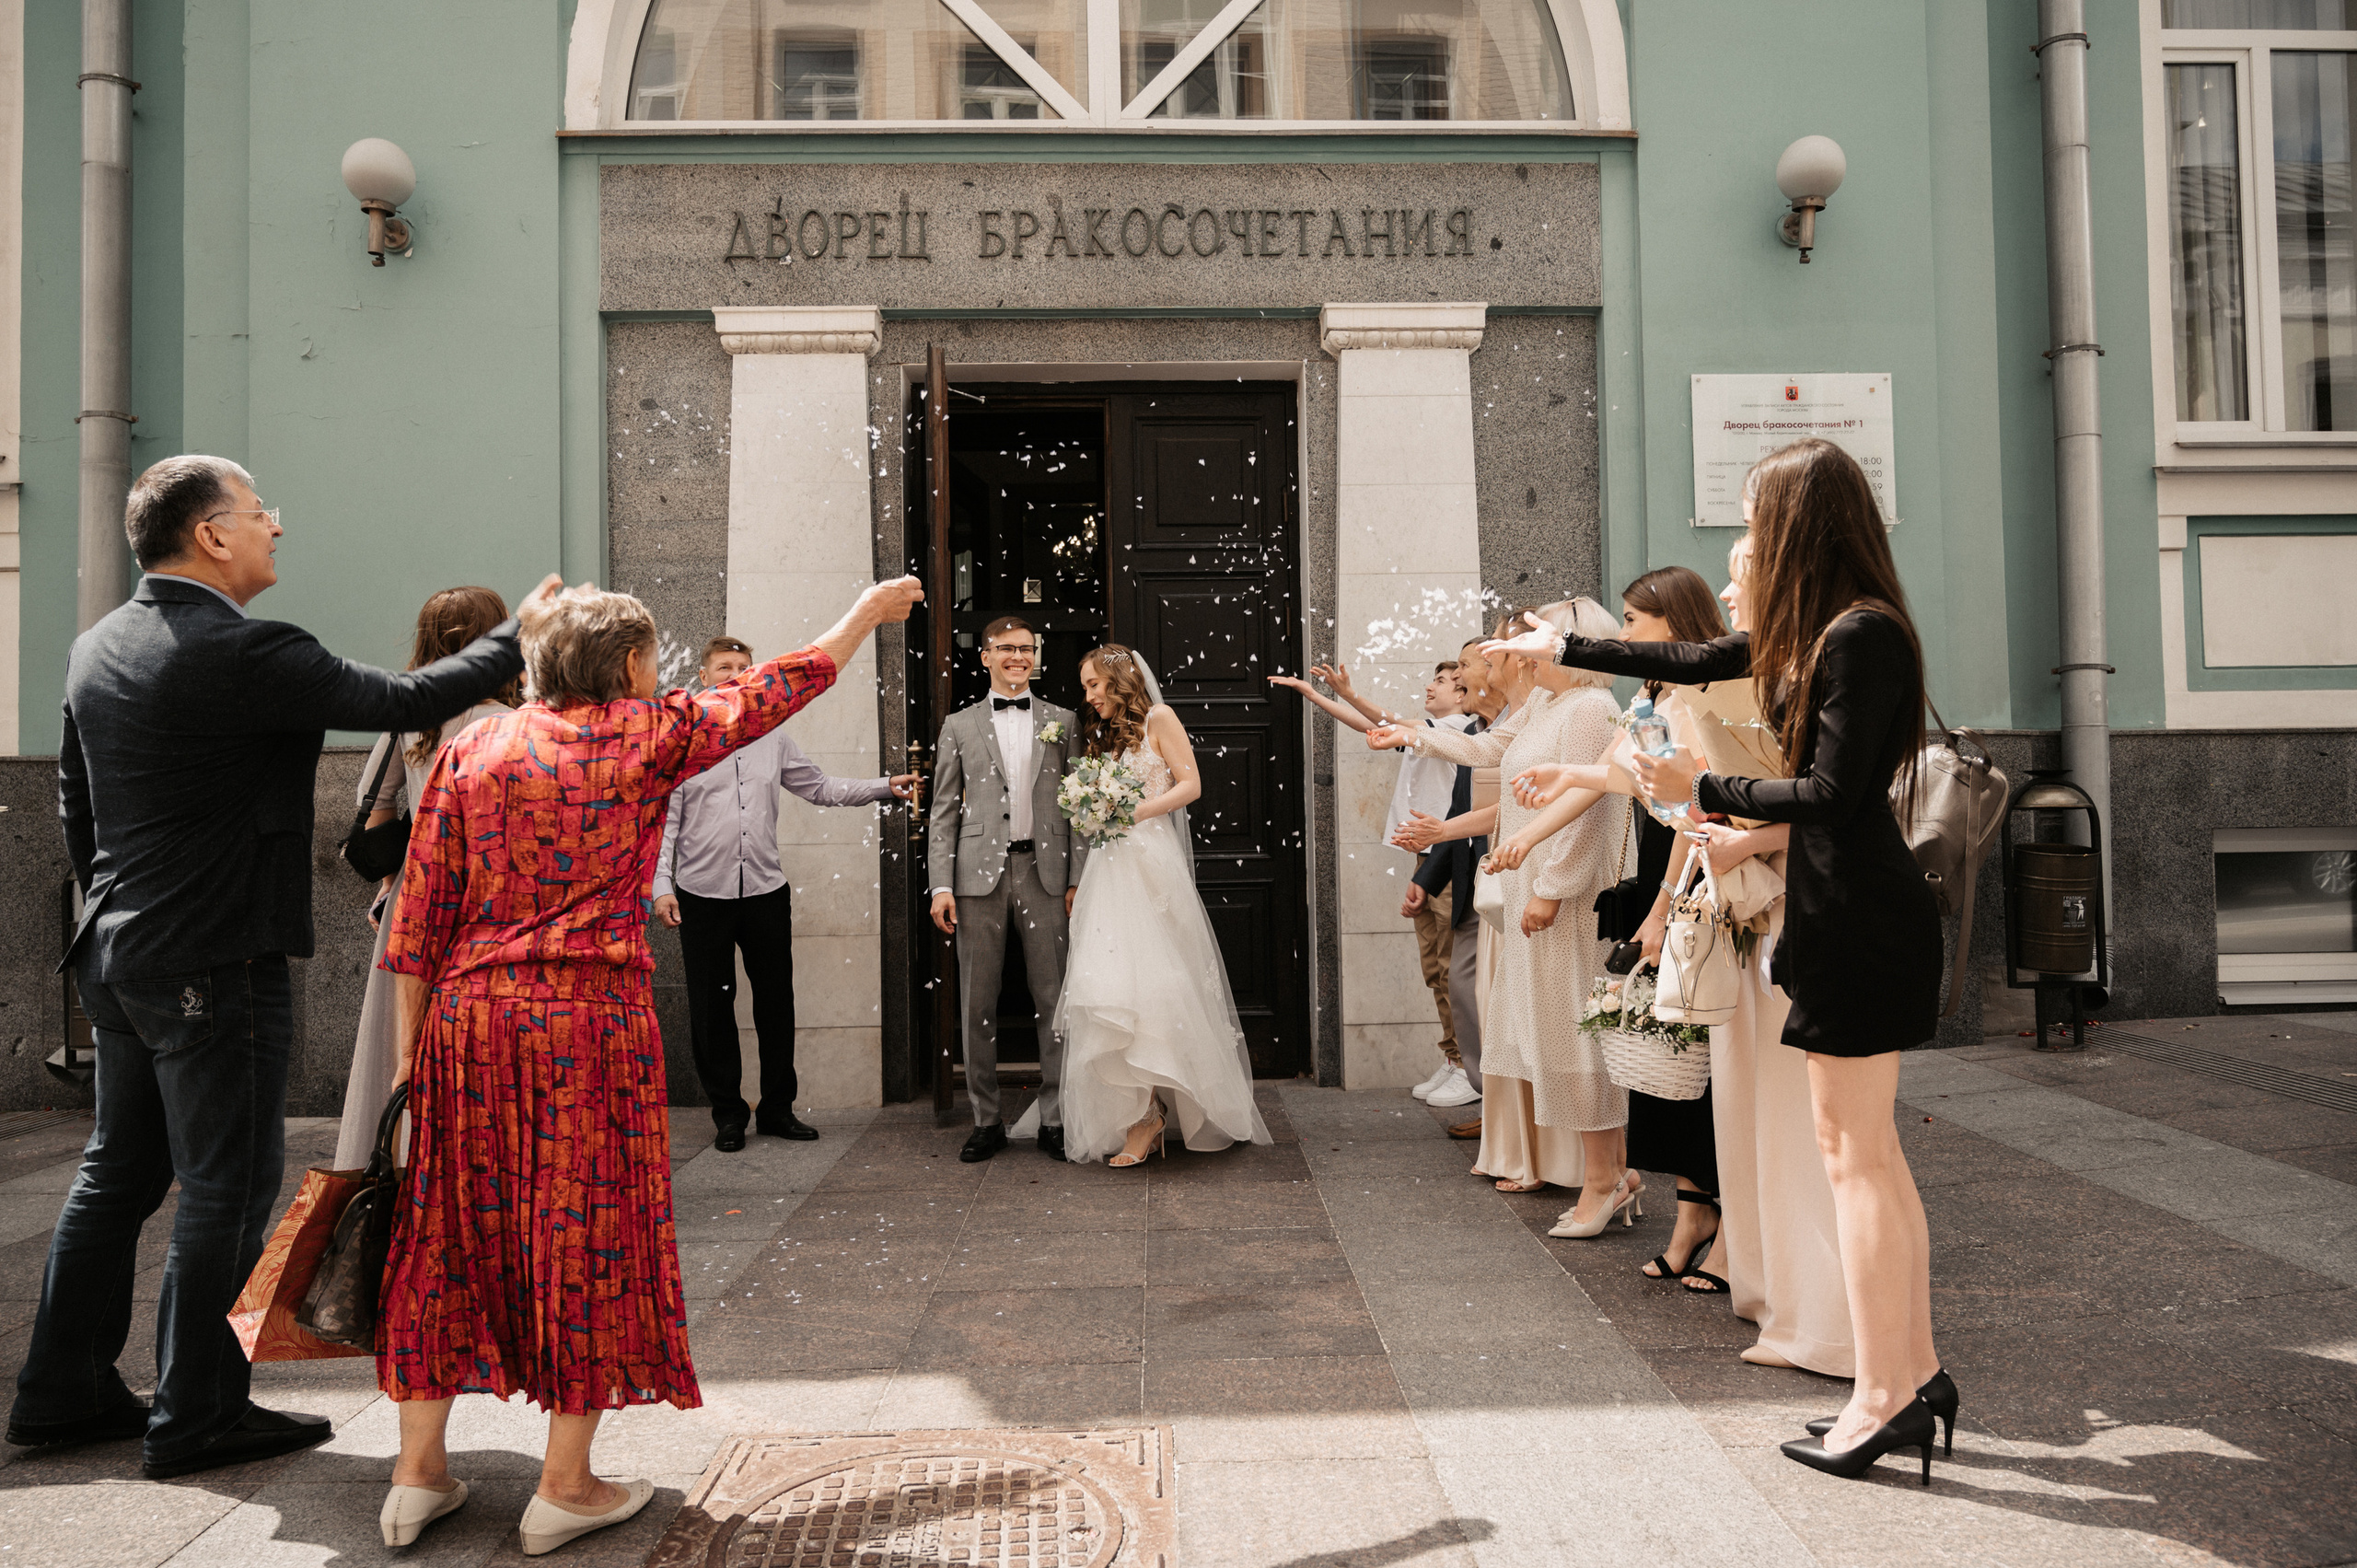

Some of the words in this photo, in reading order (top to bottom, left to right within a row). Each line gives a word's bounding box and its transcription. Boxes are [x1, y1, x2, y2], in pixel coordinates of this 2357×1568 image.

[724, 208, 932, 263] ДВОРЕЦ
[978, 205, 1473, 259] БРАКОСОЧЕТАНИЯ
[1724, 421, 1760, 431] Дворец
[1762, 420, 1840, 431] бракосочетания
[1859, 420, 1864, 428] 1
[1860, 457, 1882, 465] 18:00
[1864, 470, 1882, 478] 2:00
